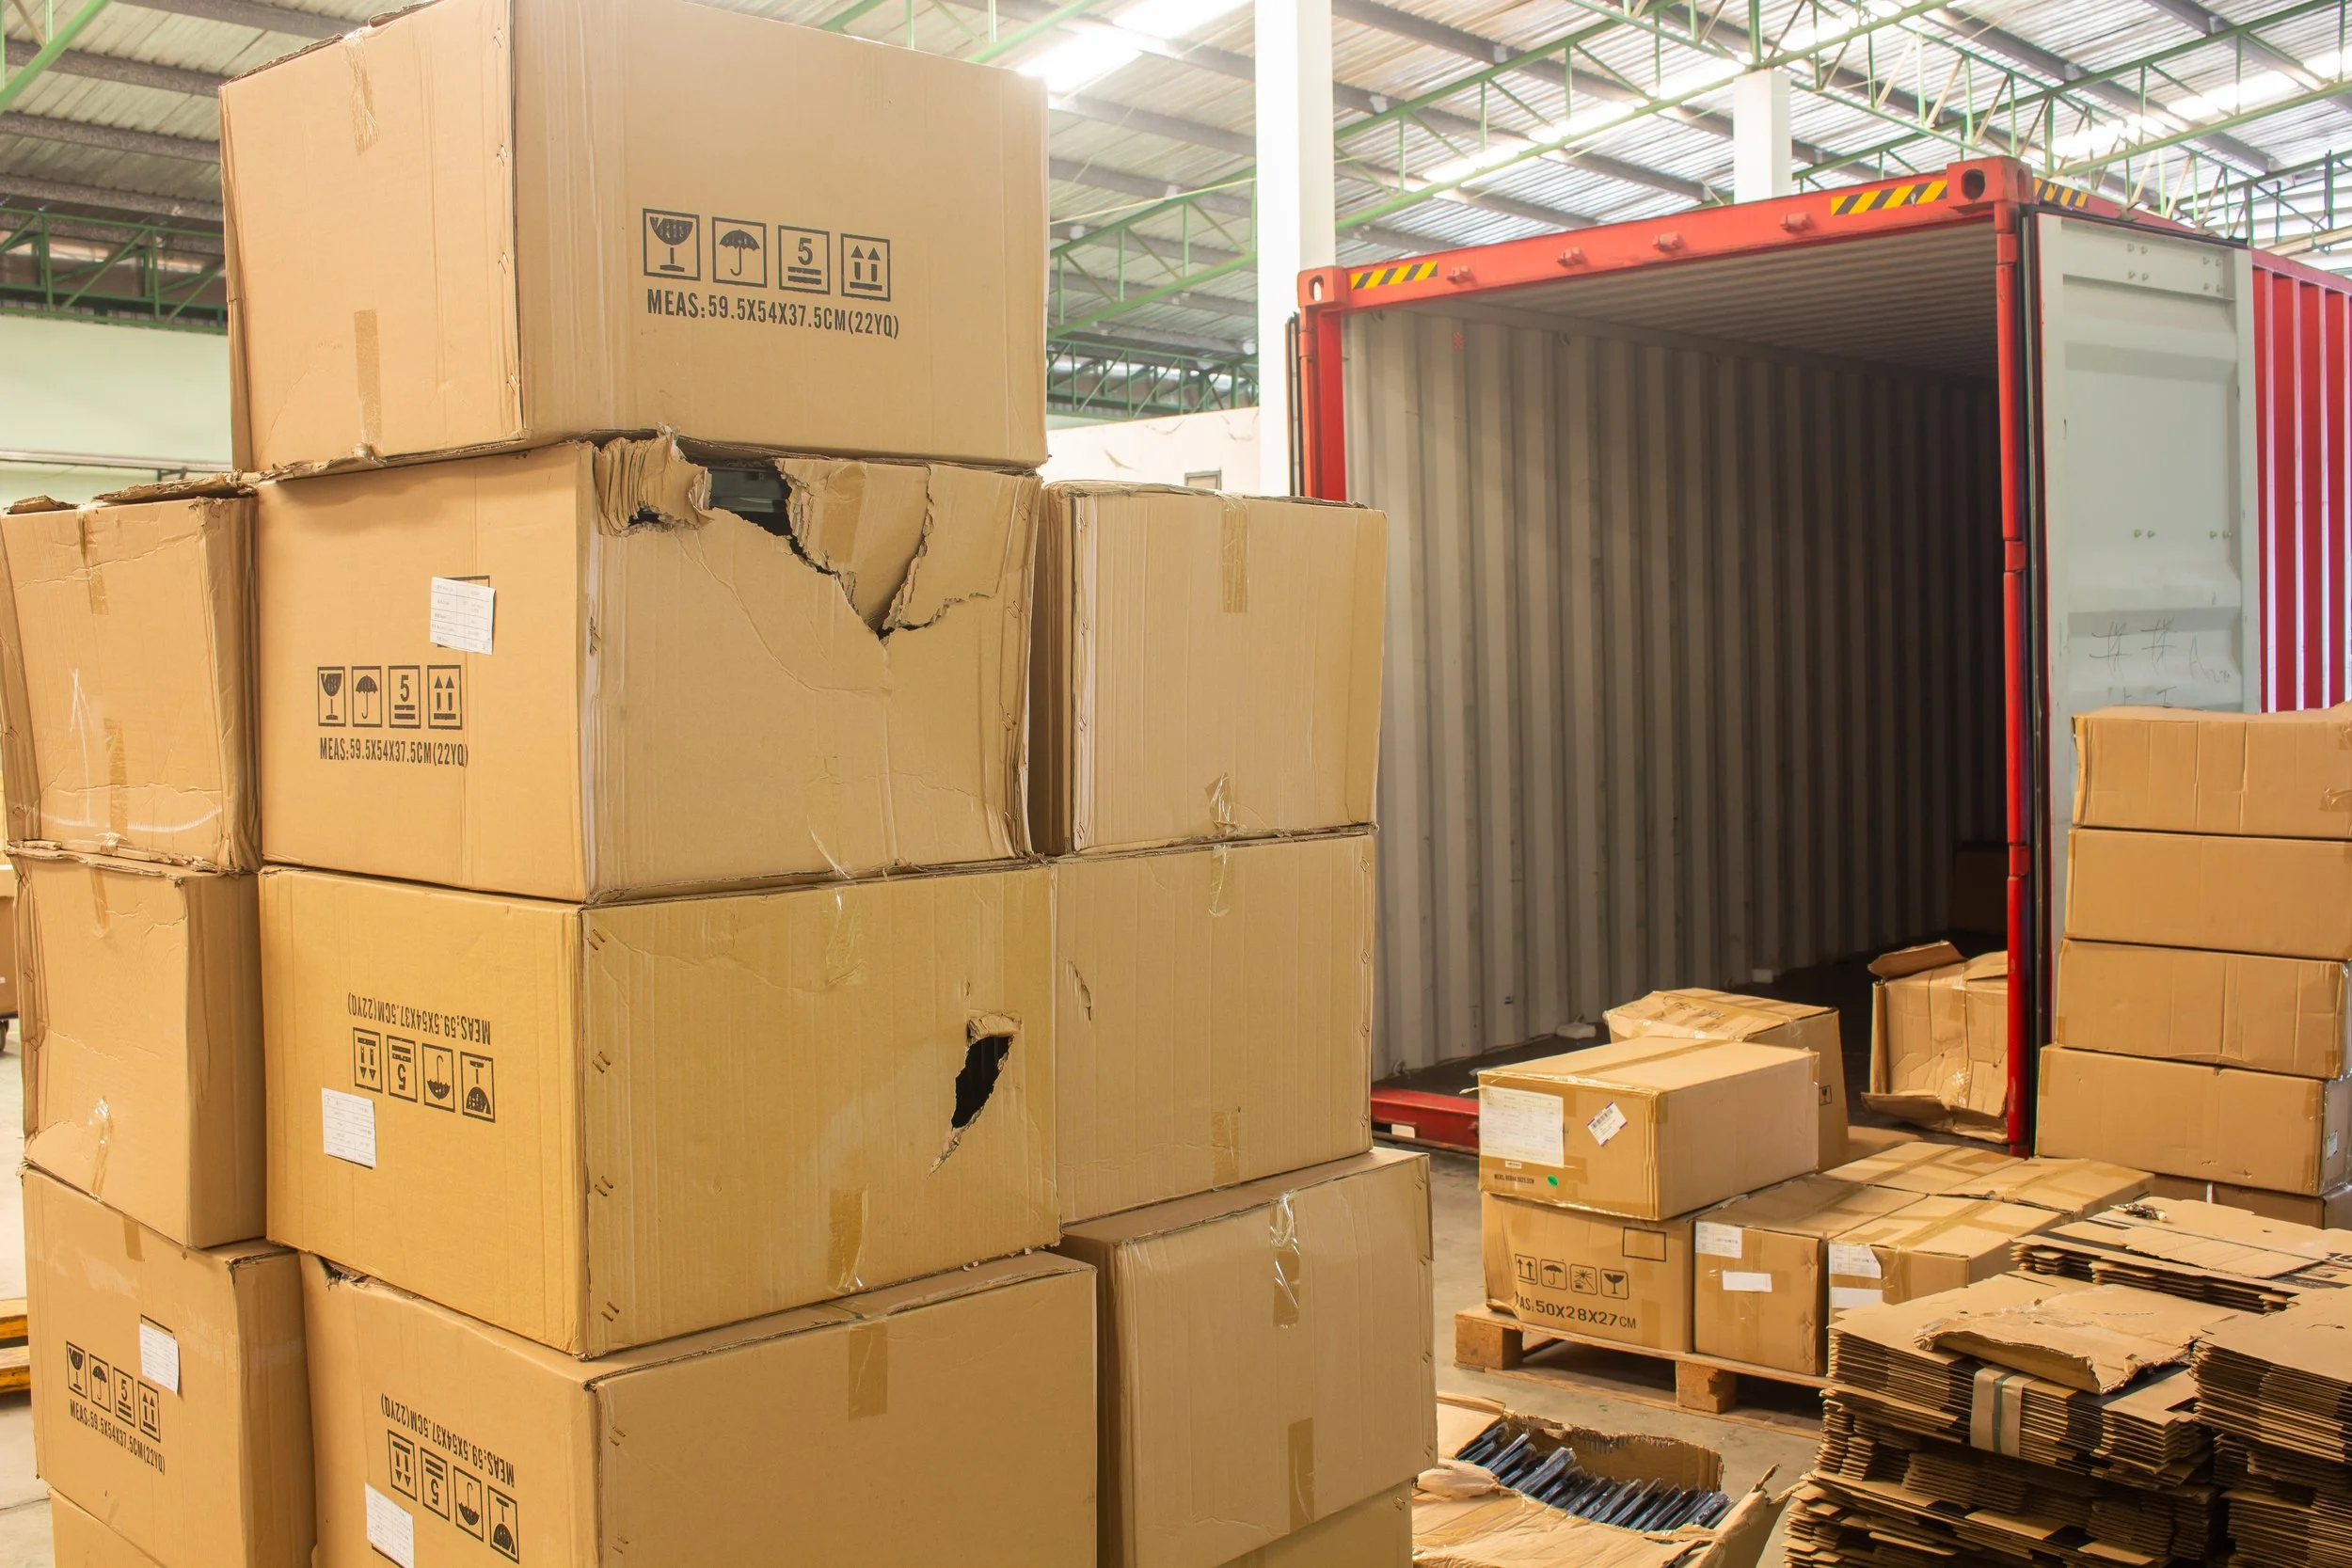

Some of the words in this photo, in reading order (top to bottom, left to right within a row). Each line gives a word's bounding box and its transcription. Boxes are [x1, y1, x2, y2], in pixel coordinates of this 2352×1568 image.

[798, 237, 814, 265] 5
[646, 288, 899, 340] MEAS:59.5X54X37.5CM(22YQ)
[400, 674, 410, 702] 5
[320, 736, 469, 768] MEAS:59.5X54X37.5CM(22YQ)
[347, 991, 491, 1045] MEAS:59.5X54X37.5CM(22YQ)
[397, 1064, 406, 1091] 5
[121, 1378, 129, 1402] 5
[70, 1399, 166, 1475] MEAS:59.5X54X37.5CM(22YQ)
[380, 1392, 516, 1488] MEAS:59.5X54X37.5CM(22YQ)
[430, 1478, 439, 1506] 5
